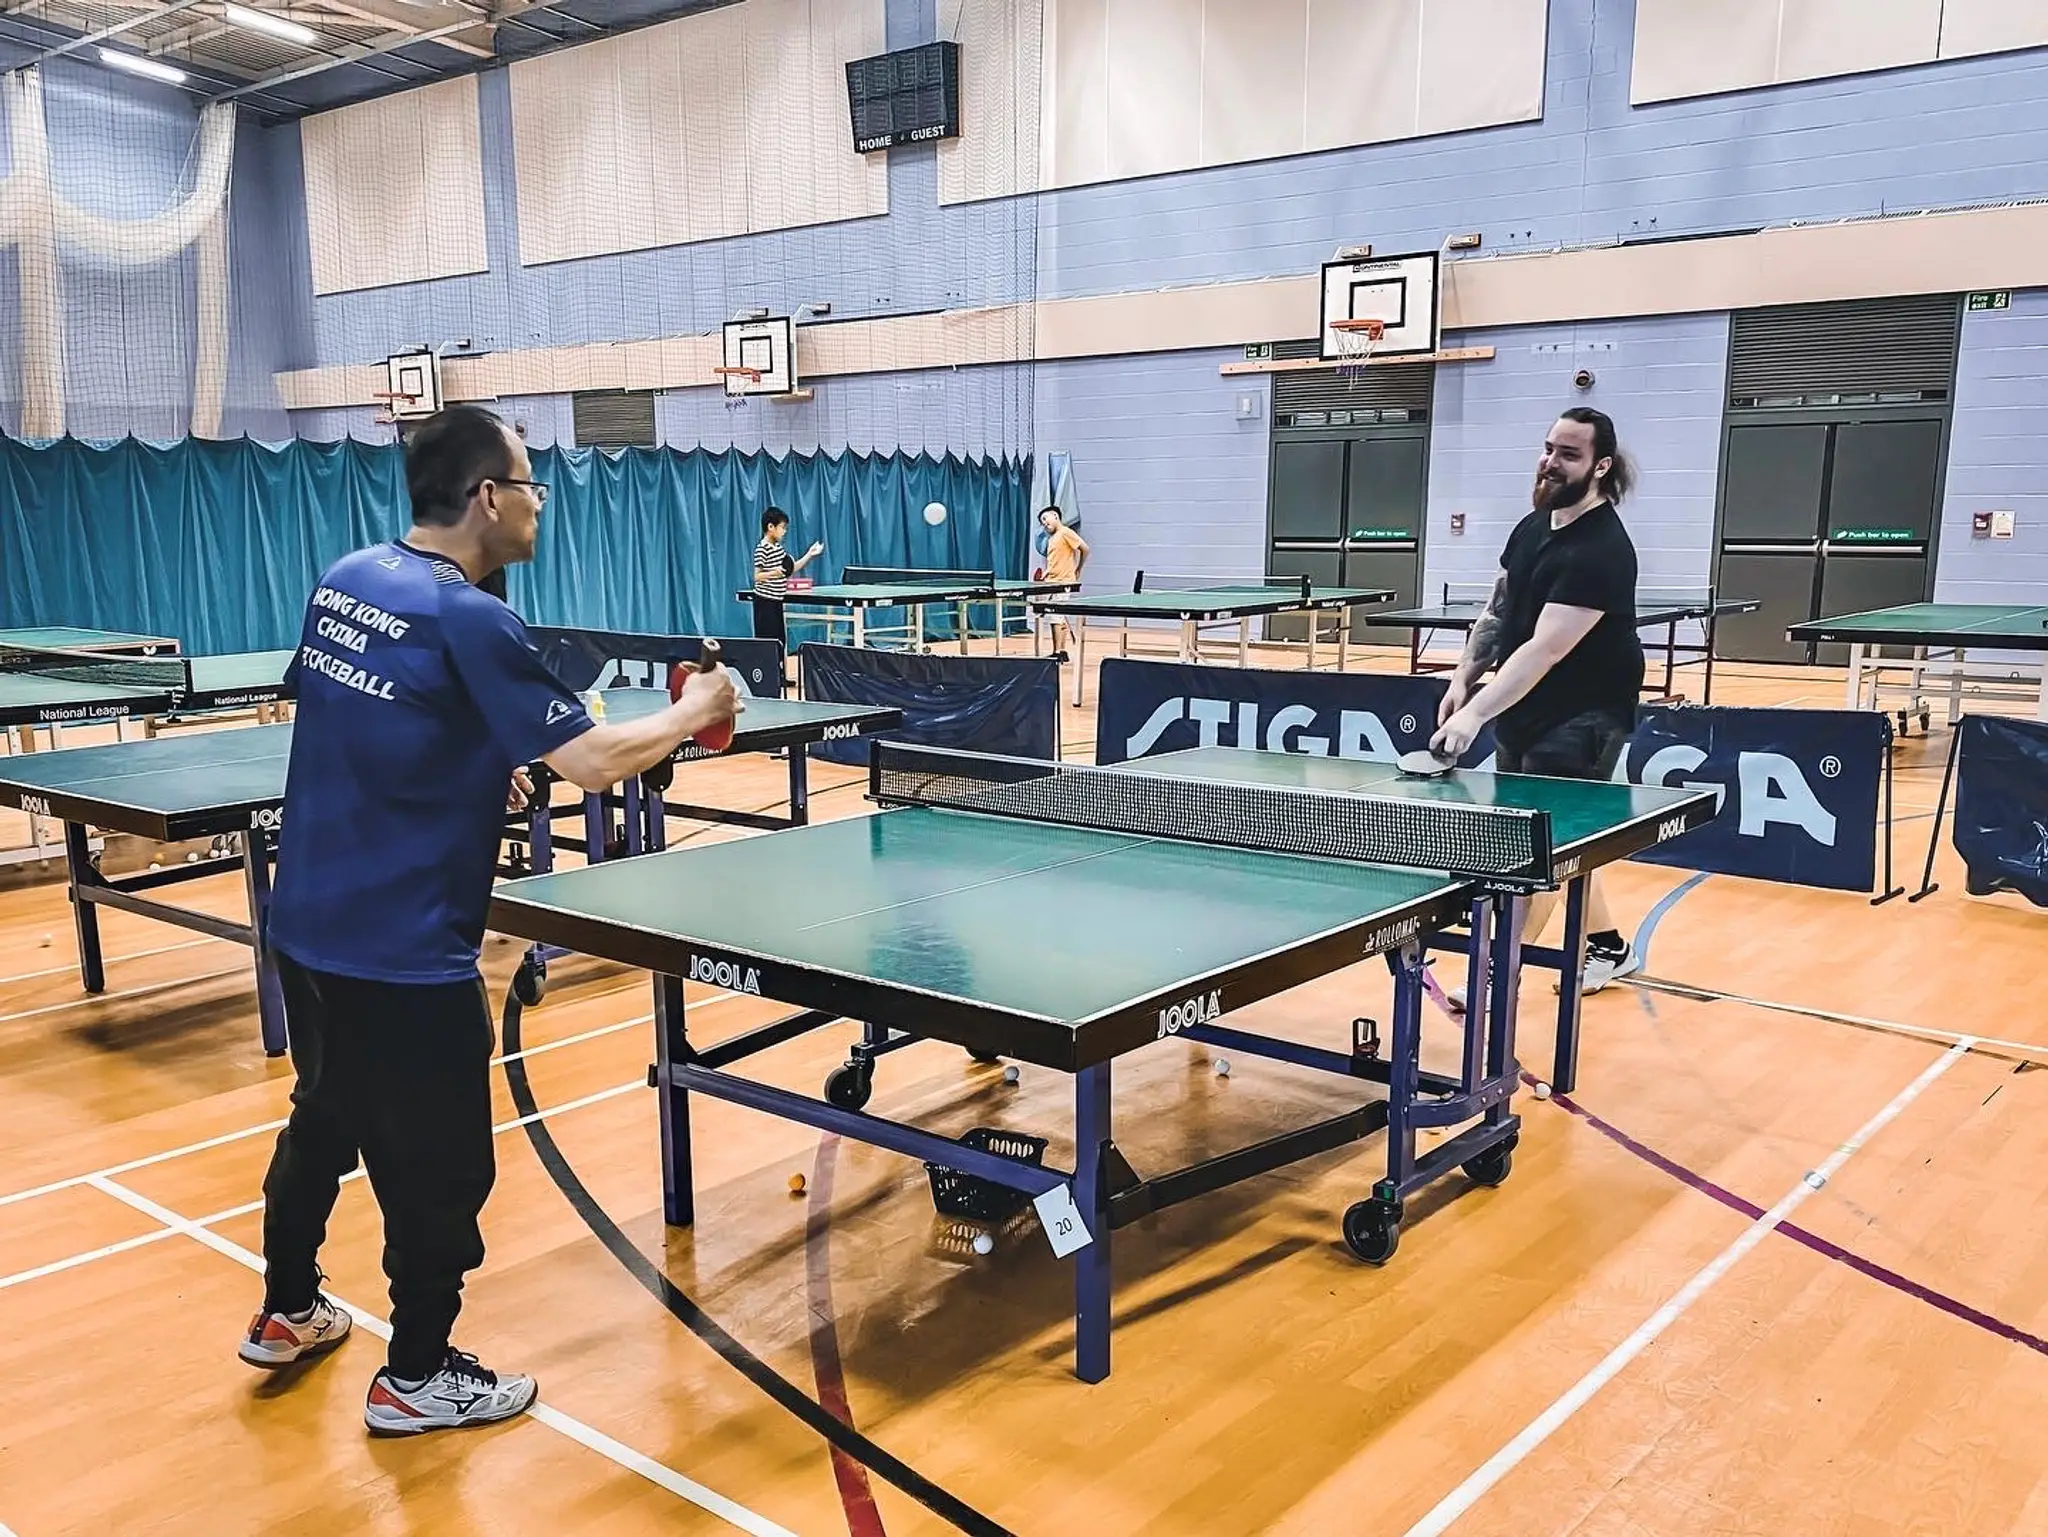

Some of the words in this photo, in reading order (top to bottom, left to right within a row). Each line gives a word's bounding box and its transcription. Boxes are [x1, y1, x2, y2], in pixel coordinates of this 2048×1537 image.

[859, 135, 892, 151] HOME
[911, 125, 946, 141] GUEST
[312, 587, 357, 616] HONG
[350, 602, 411, 640] KONG
[317, 615, 369, 654] CHINA
[40, 706, 87, 721] National
[89, 703, 130, 717] League
[215, 694, 248, 706] National
[249, 692, 278, 703] League
[822, 722, 860, 741] JOOLA
[1126, 697, 1402, 764] STIGA
[20, 793, 51, 816] JOOLA
[1657, 815, 1686, 843] JOOLA
[1492, 882, 1525, 893] JOOLA
[689, 953, 761, 996] JOOLA
[1157, 990, 1221, 1040] JOOLA
[1055, 1217, 1073, 1236] 20
